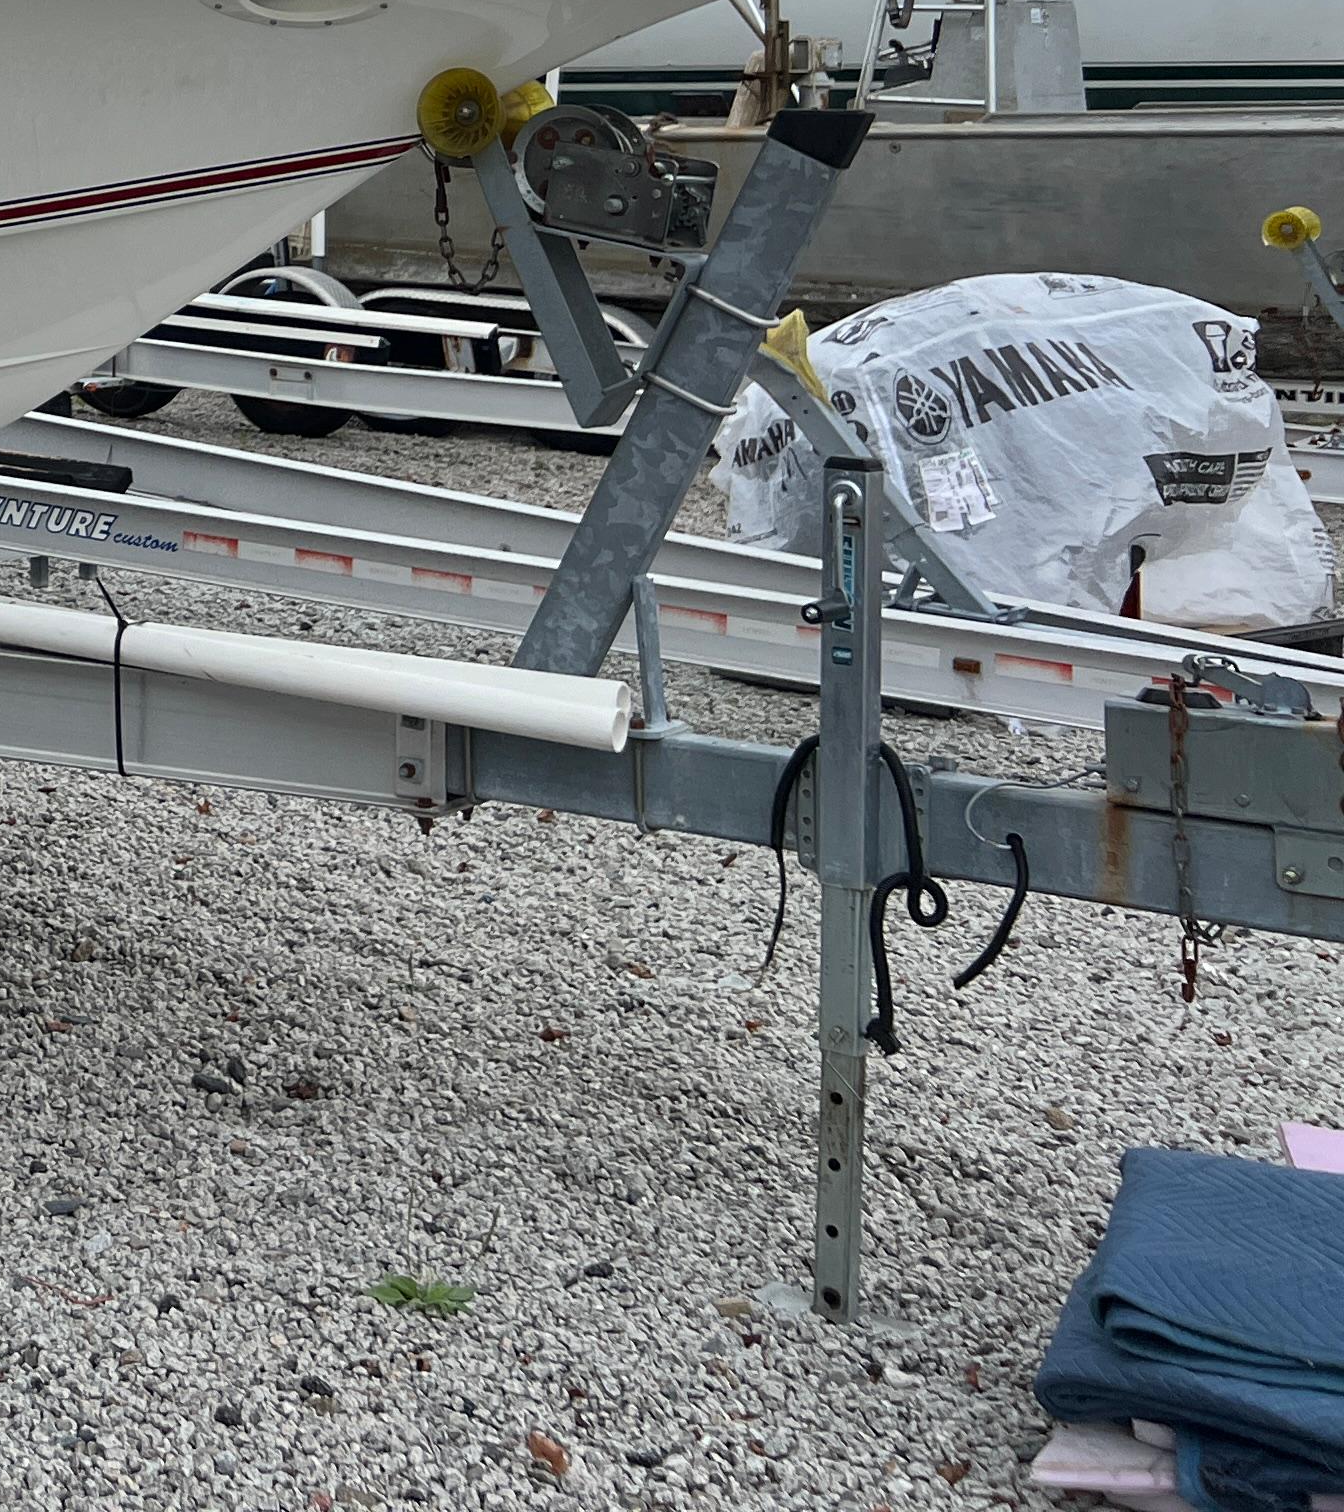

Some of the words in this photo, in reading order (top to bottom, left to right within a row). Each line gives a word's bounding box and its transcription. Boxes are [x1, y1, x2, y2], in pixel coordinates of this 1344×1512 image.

[929, 338, 1135, 428] YAMAHA
[732, 418, 796, 468] AMAHA
[112, 530, 179, 553] custom
